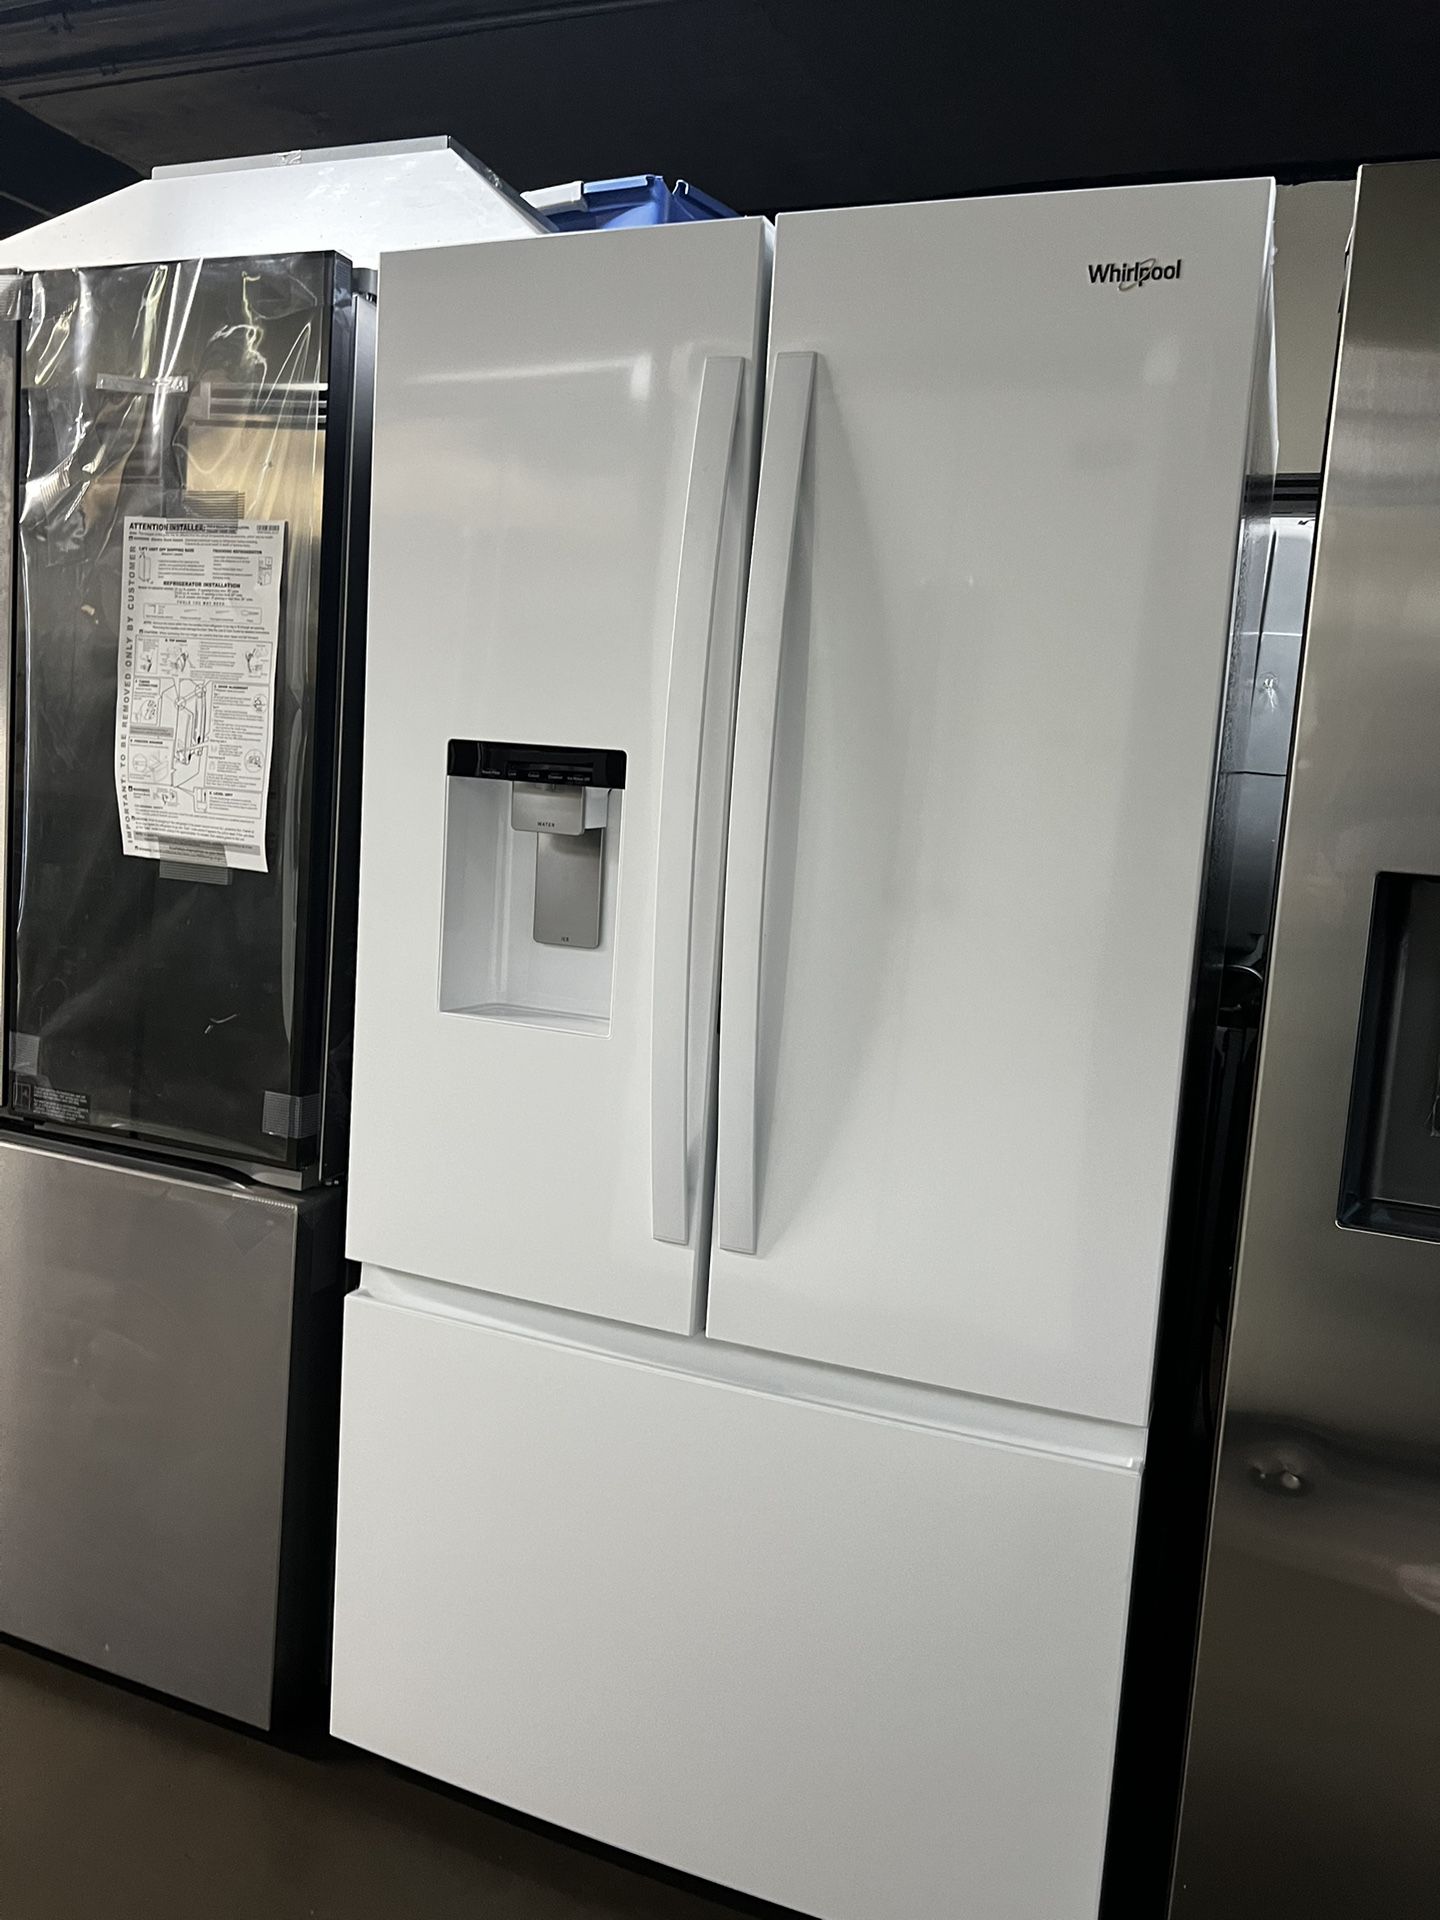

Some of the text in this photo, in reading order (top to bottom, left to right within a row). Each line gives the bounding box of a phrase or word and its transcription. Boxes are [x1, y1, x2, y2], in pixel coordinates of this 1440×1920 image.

[1088, 258, 1182, 288] Whirlpool
[129, 522, 168, 531] ATTENTION
[127, 545, 137, 610] CUSTOMER
[126, 616, 135, 631] BY
[124, 636, 134, 668] ONLY
[121, 675, 132, 728] REMOVED
[120, 734, 128, 748] BE
[120, 754, 126, 768] TO
